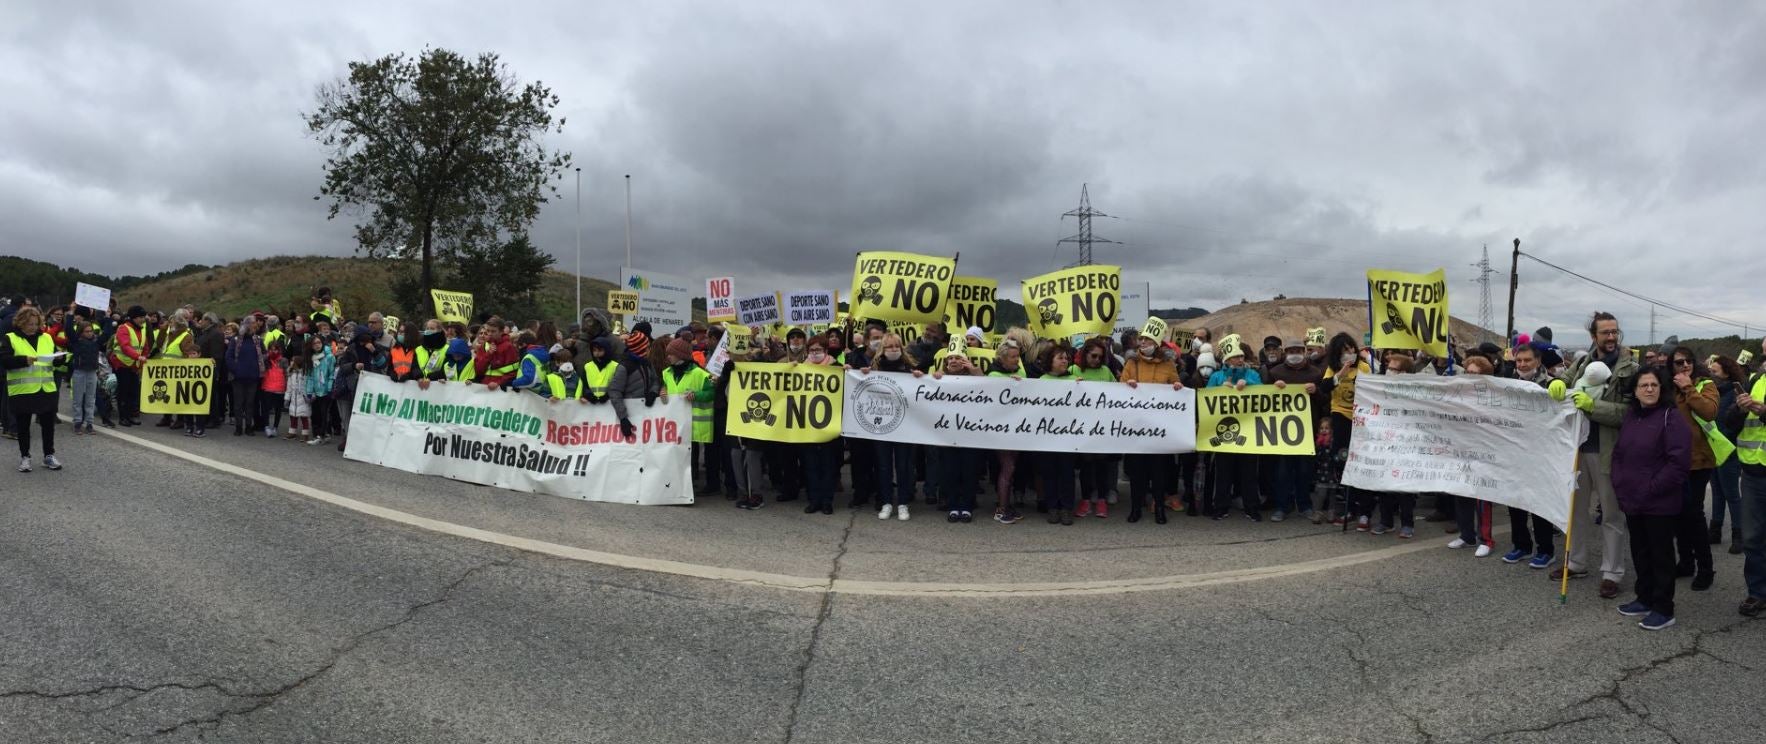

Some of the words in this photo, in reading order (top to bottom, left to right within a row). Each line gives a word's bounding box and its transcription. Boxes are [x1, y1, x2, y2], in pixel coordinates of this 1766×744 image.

[860, 258, 950, 281] VERTEDERO
[710, 279, 730, 298] NO
[891, 278, 940, 314] NO
[1028, 273, 1120, 300] VERTEDERO
[434, 292, 472, 306] VERTEDERO
[622, 300, 636, 311] NO
[740, 297, 760, 312] DEPORTE
[761, 296, 776, 307] SANO
[790, 296, 814, 308] DEPORTE
[814, 295, 829, 306] SANO
[1072, 292, 1116, 323] NO
[456, 302, 471, 320] NO
[709, 308, 734, 316] MENTIRAS
[743, 312, 754, 324] CON
[754, 310, 765, 322] AIRE
[765, 308, 778, 320] SANO
[792, 310, 803, 322] CON
[804, 309, 814, 321] AIRE
[815, 308, 830, 320] SANO
[957, 302, 995, 332] NO
[1146, 324, 1160, 337] NO
[1184, 340, 1193, 350] N
[148, 364, 211, 380] VERTEDERO
[738, 371, 840, 394] VERTEDERO
[176, 380, 208, 405] NO
[916, 385, 994, 404] Federación
[999, 388, 1072, 408] Comarcal
[1076, 393, 1092, 408] de
[1098, 394, 1187, 412] Asociaciones
[786, 395, 832, 430] NO
[1205, 393, 1307, 416] VERTEDERO
[376, 394, 396, 416] No
[398, 398, 416, 420] Al
[417, 402, 544, 440] Macrovertedero,
[656, 417, 682, 444] Ya,
[934, 414, 950, 430] de
[956, 414, 1010, 434] Vecinos
[1015, 418, 1032, 434] de
[1036, 418, 1084, 436] Alcalá
[1090, 420, 1106, 436] de
[1110, 420, 1167, 438] Henares
[1256, 415, 1304, 446] NO
[424, 432, 448, 456] Por
[574, 454, 590, 476] !!
